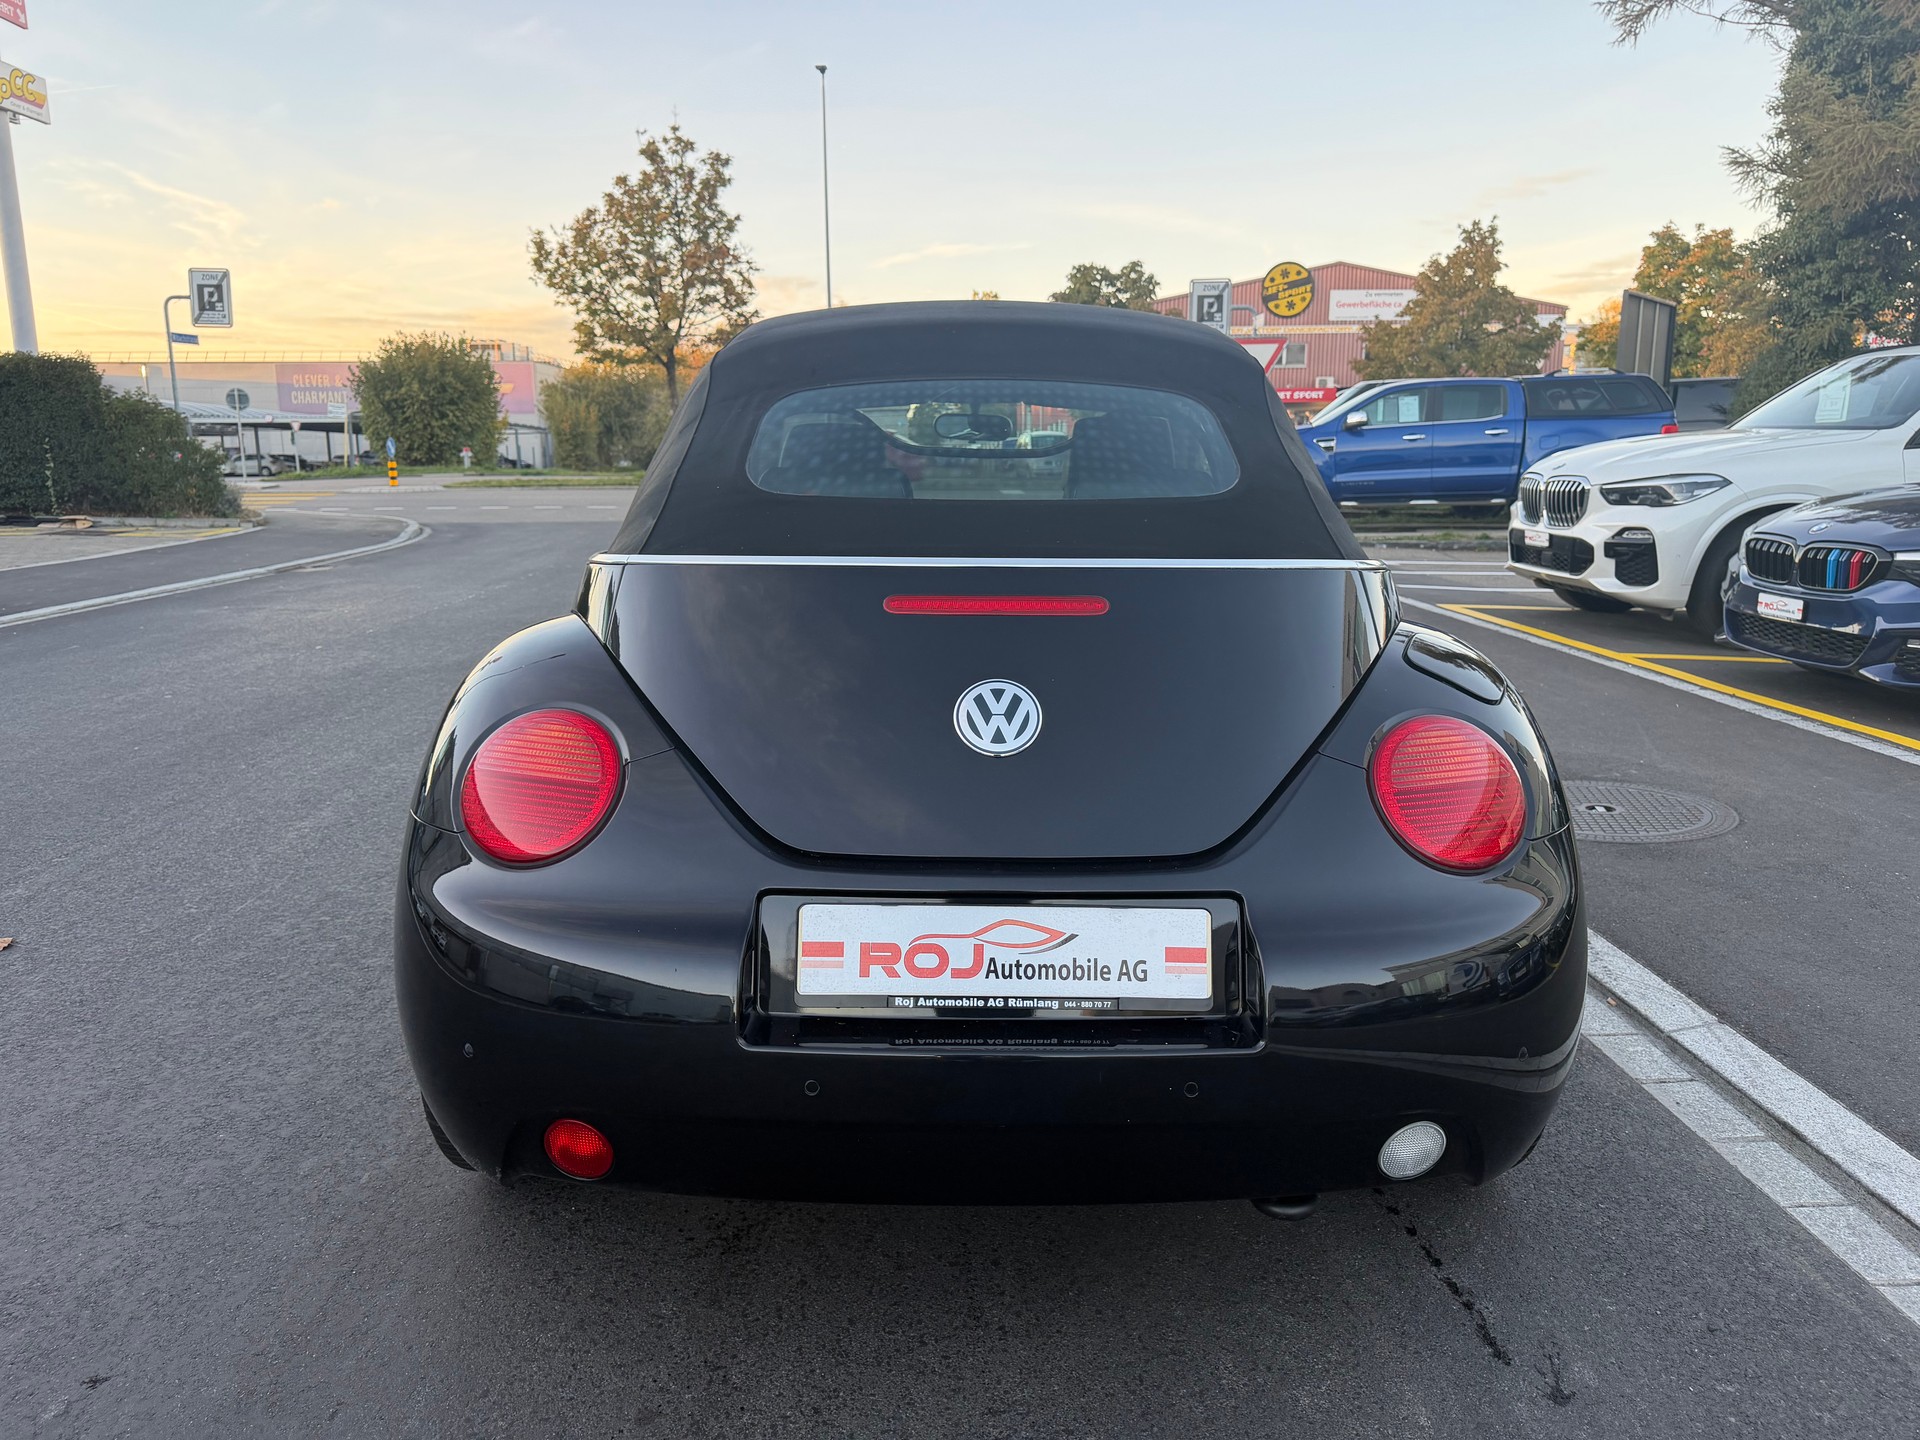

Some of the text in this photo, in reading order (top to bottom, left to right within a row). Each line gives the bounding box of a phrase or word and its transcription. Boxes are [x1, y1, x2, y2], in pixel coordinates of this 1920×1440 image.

[293, 374, 343, 388] CLEVER &
[291, 390, 347, 404] CHARMANT
[1293, 391, 1324, 399] SPORT
[859, 942, 1148, 982] ROJ Automobile AG
[895, 997, 914, 1008] Roj
[917, 997, 984, 1007] Automobile
[987, 998, 1004, 1007] AG
[1008, 997, 1059, 1009] Rümlang
